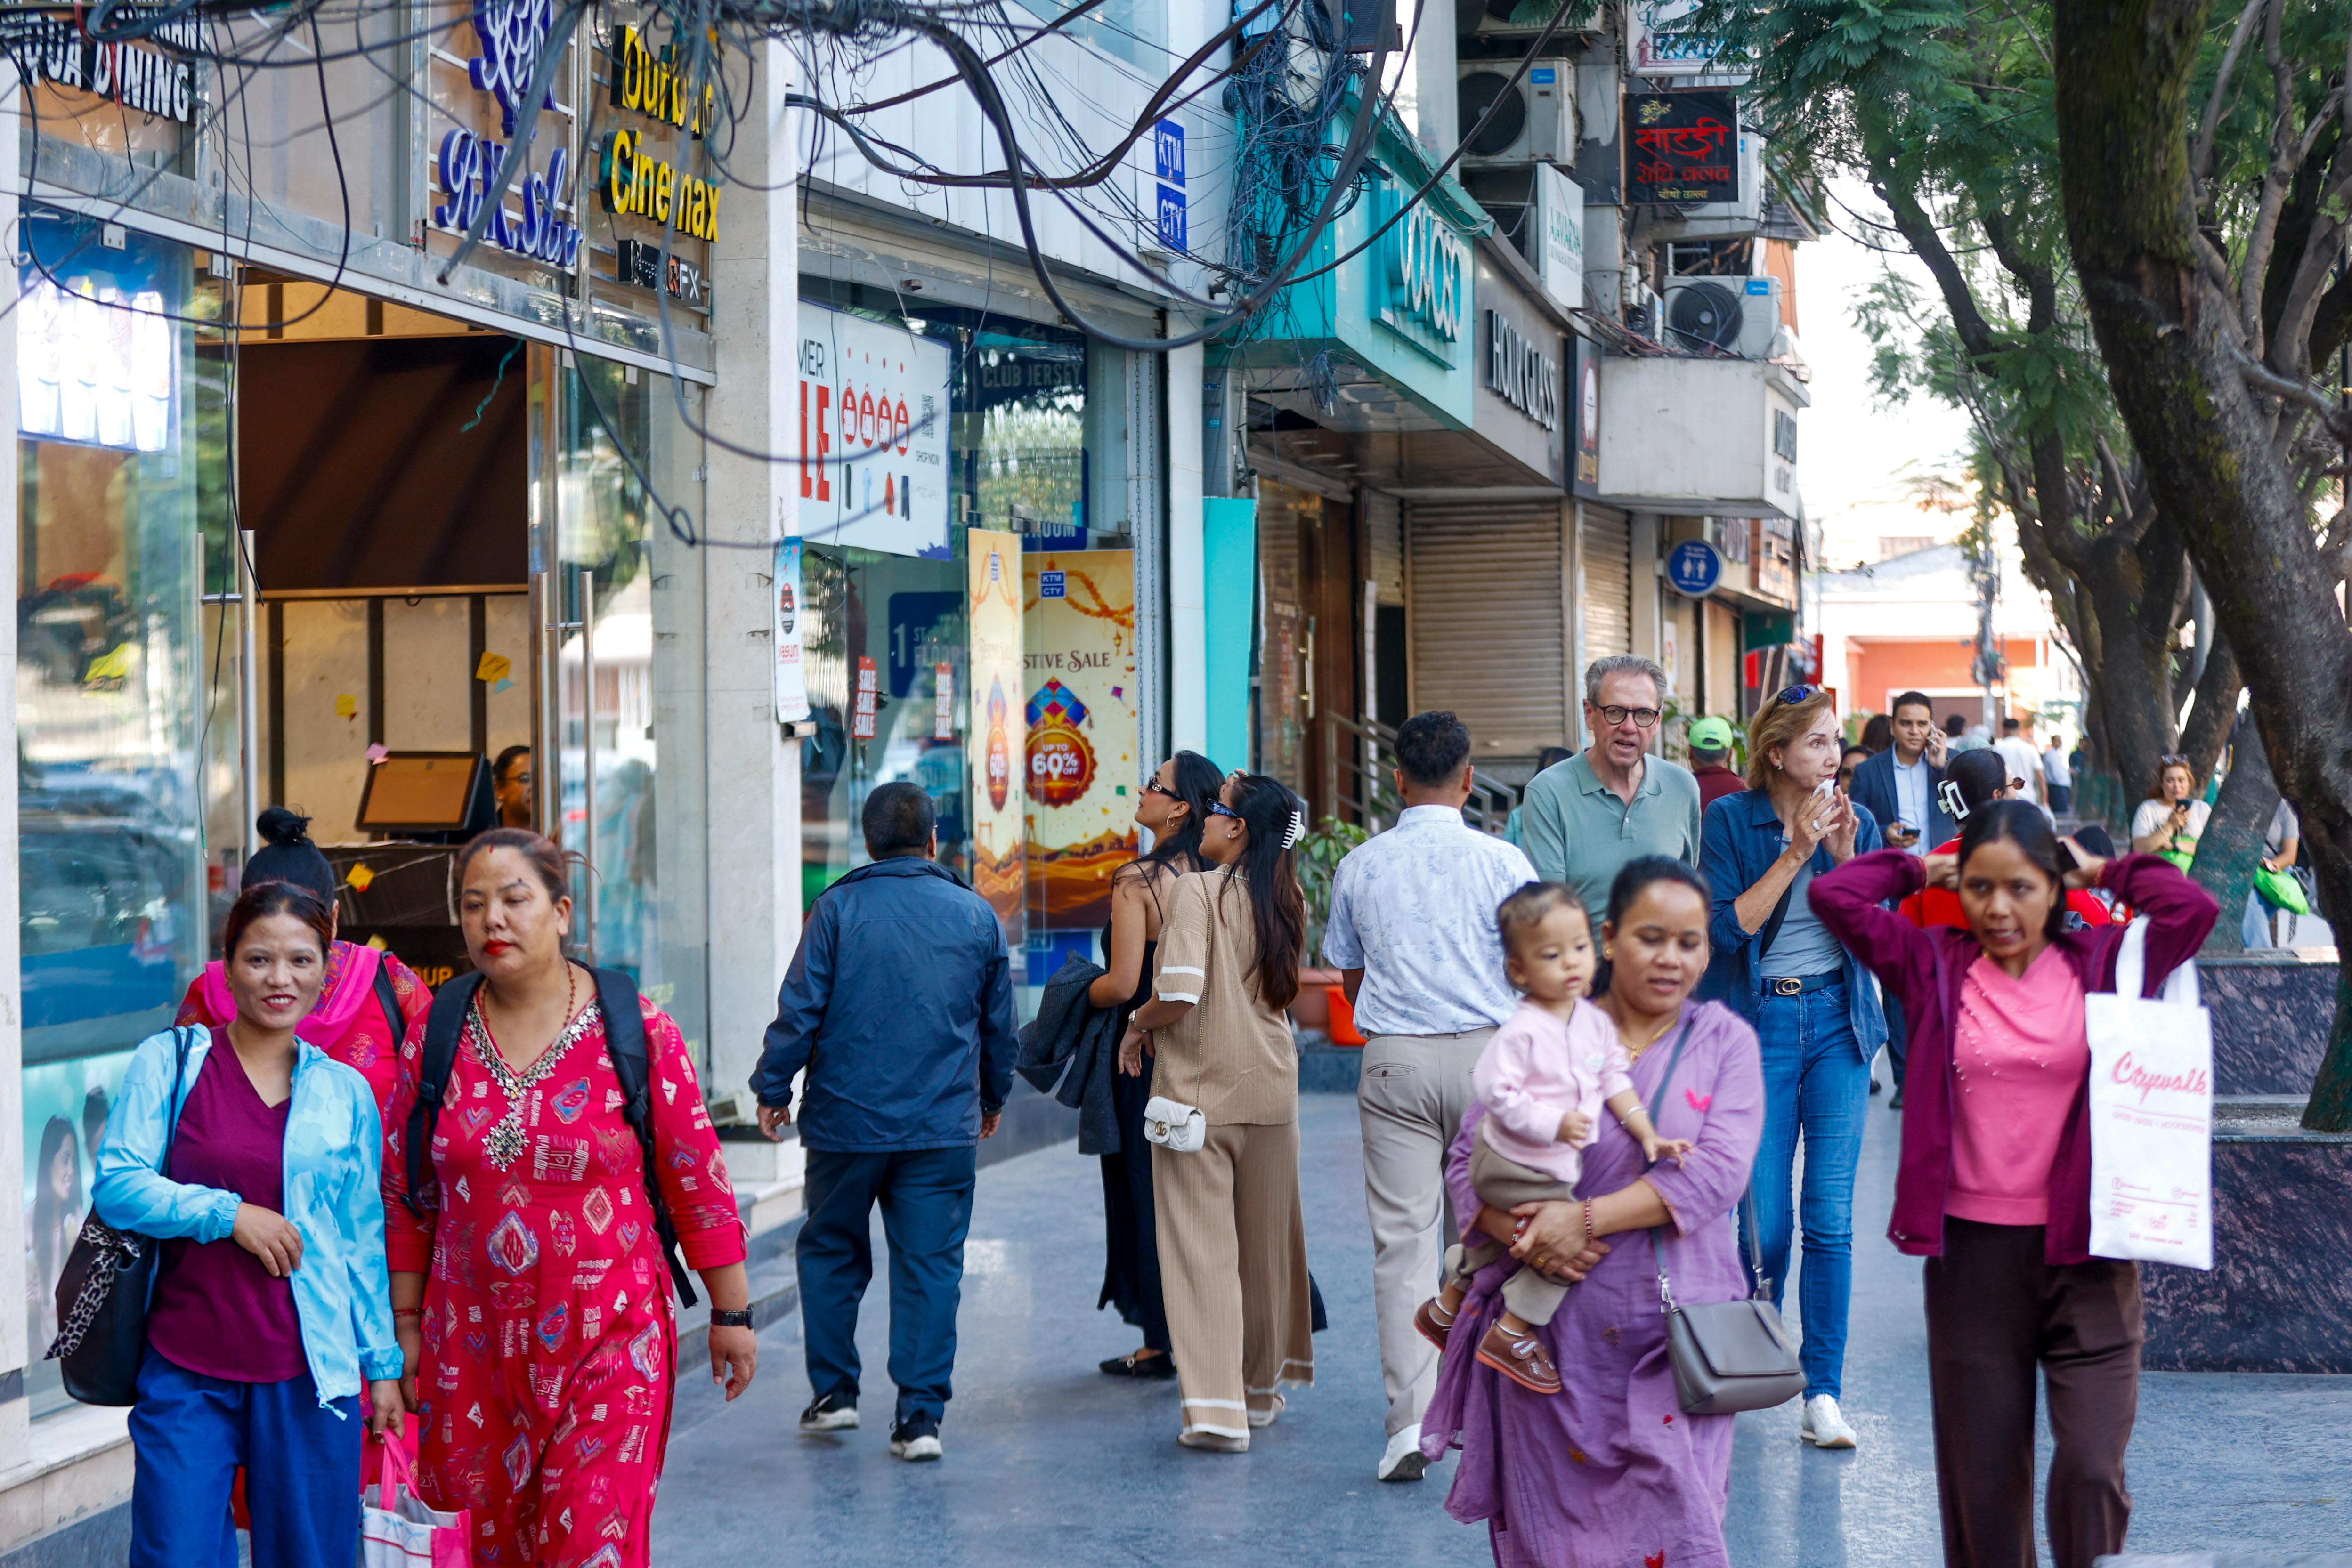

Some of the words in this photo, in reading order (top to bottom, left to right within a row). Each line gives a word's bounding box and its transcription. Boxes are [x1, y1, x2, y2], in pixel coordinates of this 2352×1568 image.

[94, 40, 189, 122] DINING
[1158, 130, 1182, 172] KTM
[611, 129, 721, 243] Cinemax
[1161, 198, 1182, 239] CTY
[982, 364, 1022, 388] CLUB
[1027, 362, 1080, 387] JERSEY
[1043, 587, 1061, 595] CTY
[1024, 654, 1063, 669] STIVE
[859, 669, 876, 691] SALE
[857, 692, 876, 714] SALE
[854, 714, 875, 736] SALE
[1032, 752, 1079, 776] 60%
